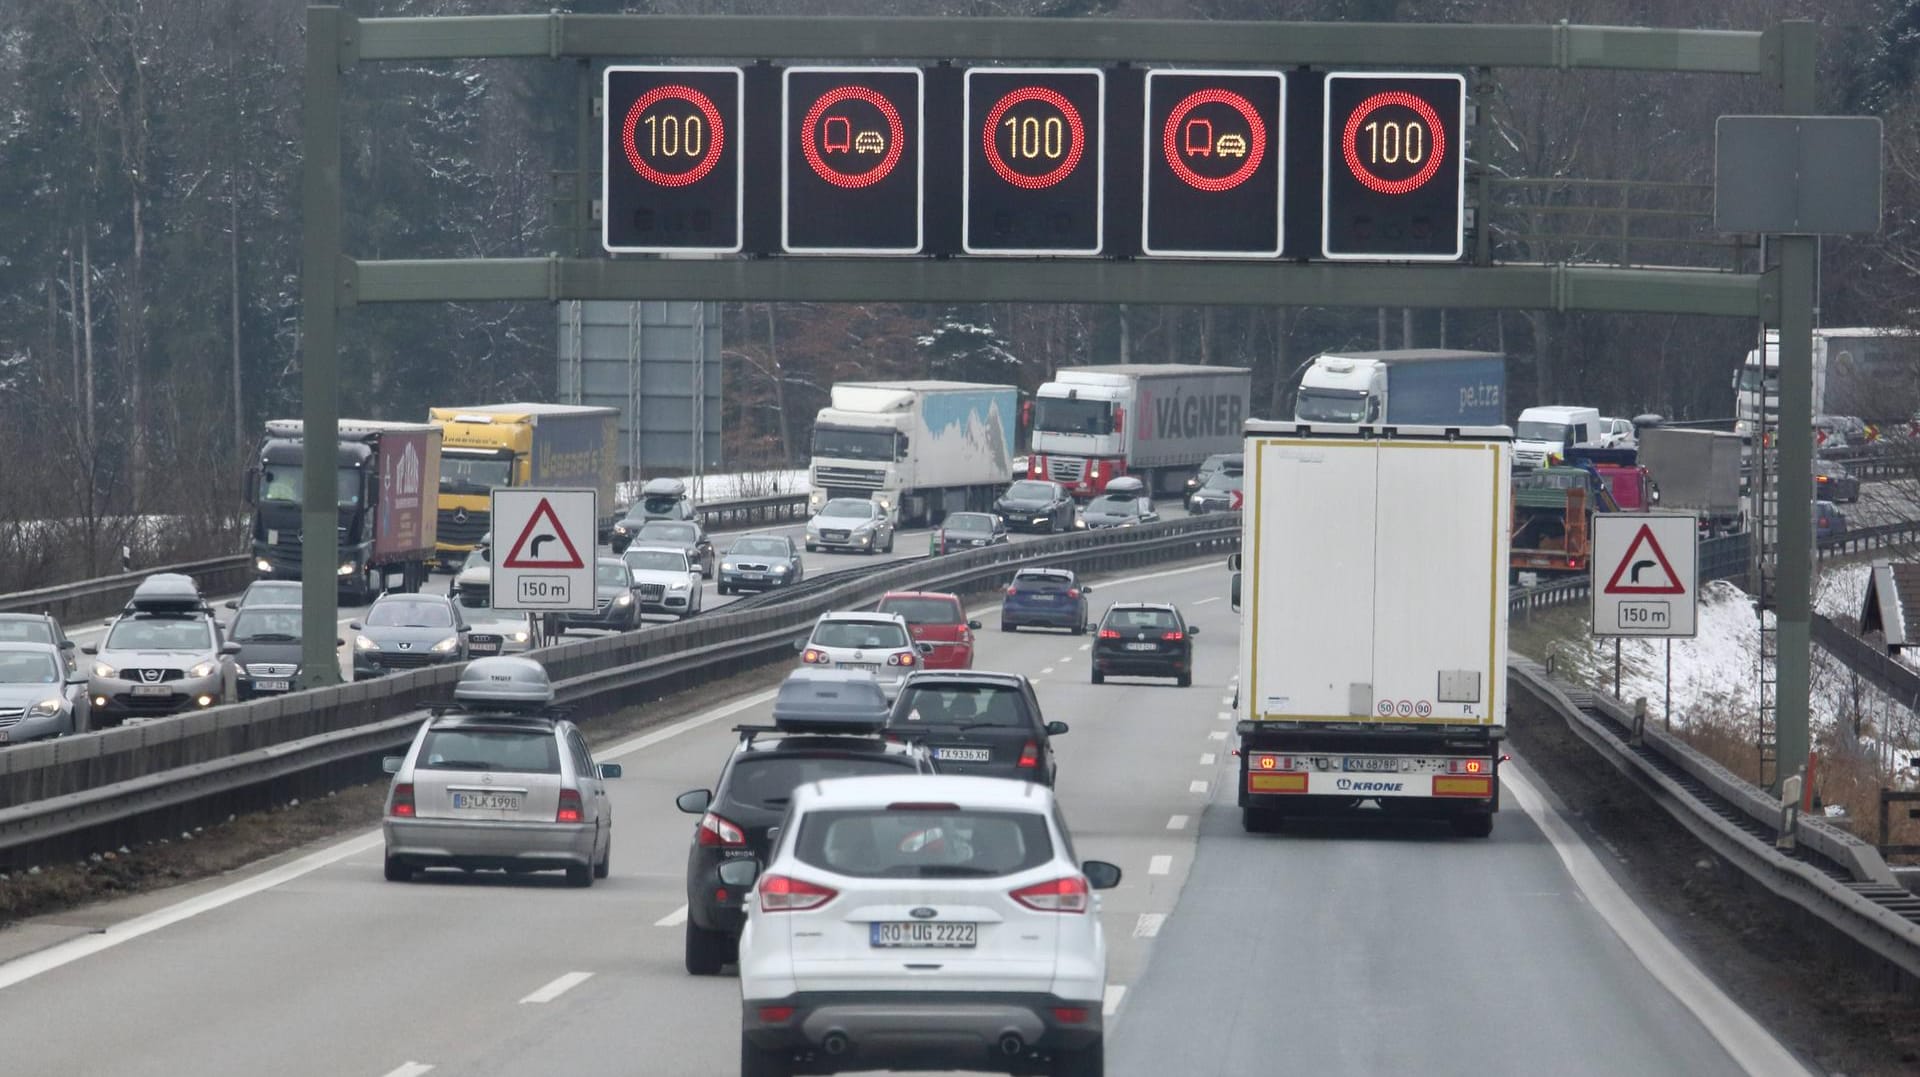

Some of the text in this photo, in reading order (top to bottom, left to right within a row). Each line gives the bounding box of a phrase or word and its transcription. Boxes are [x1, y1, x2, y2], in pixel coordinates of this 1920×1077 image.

[645, 115, 701, 156] 100
[1005, 116, 1062, 159] 100
[1365, 121, 1422, 164] 100
[1155, 386, 1241, 439] VÁGNER
[523, 582, 565, 596] 150 m
[1623, 608, 1666, 622] 150 m
[1381, 705, 1391, 713] 50
[1401, 705, 1410, 713] 70
[1418, 705, 1429, 714] 90
[1463, 705, 1473, 714] PL
[941, 750, 988, 760] TX 9336 XH
[1350, 760, 1363, 769] KN
[1353, 782, 1403, 792] KRONE
[491, 797, 517, 808] 1998
[881, 924, 974, 941] RO UG 2222
